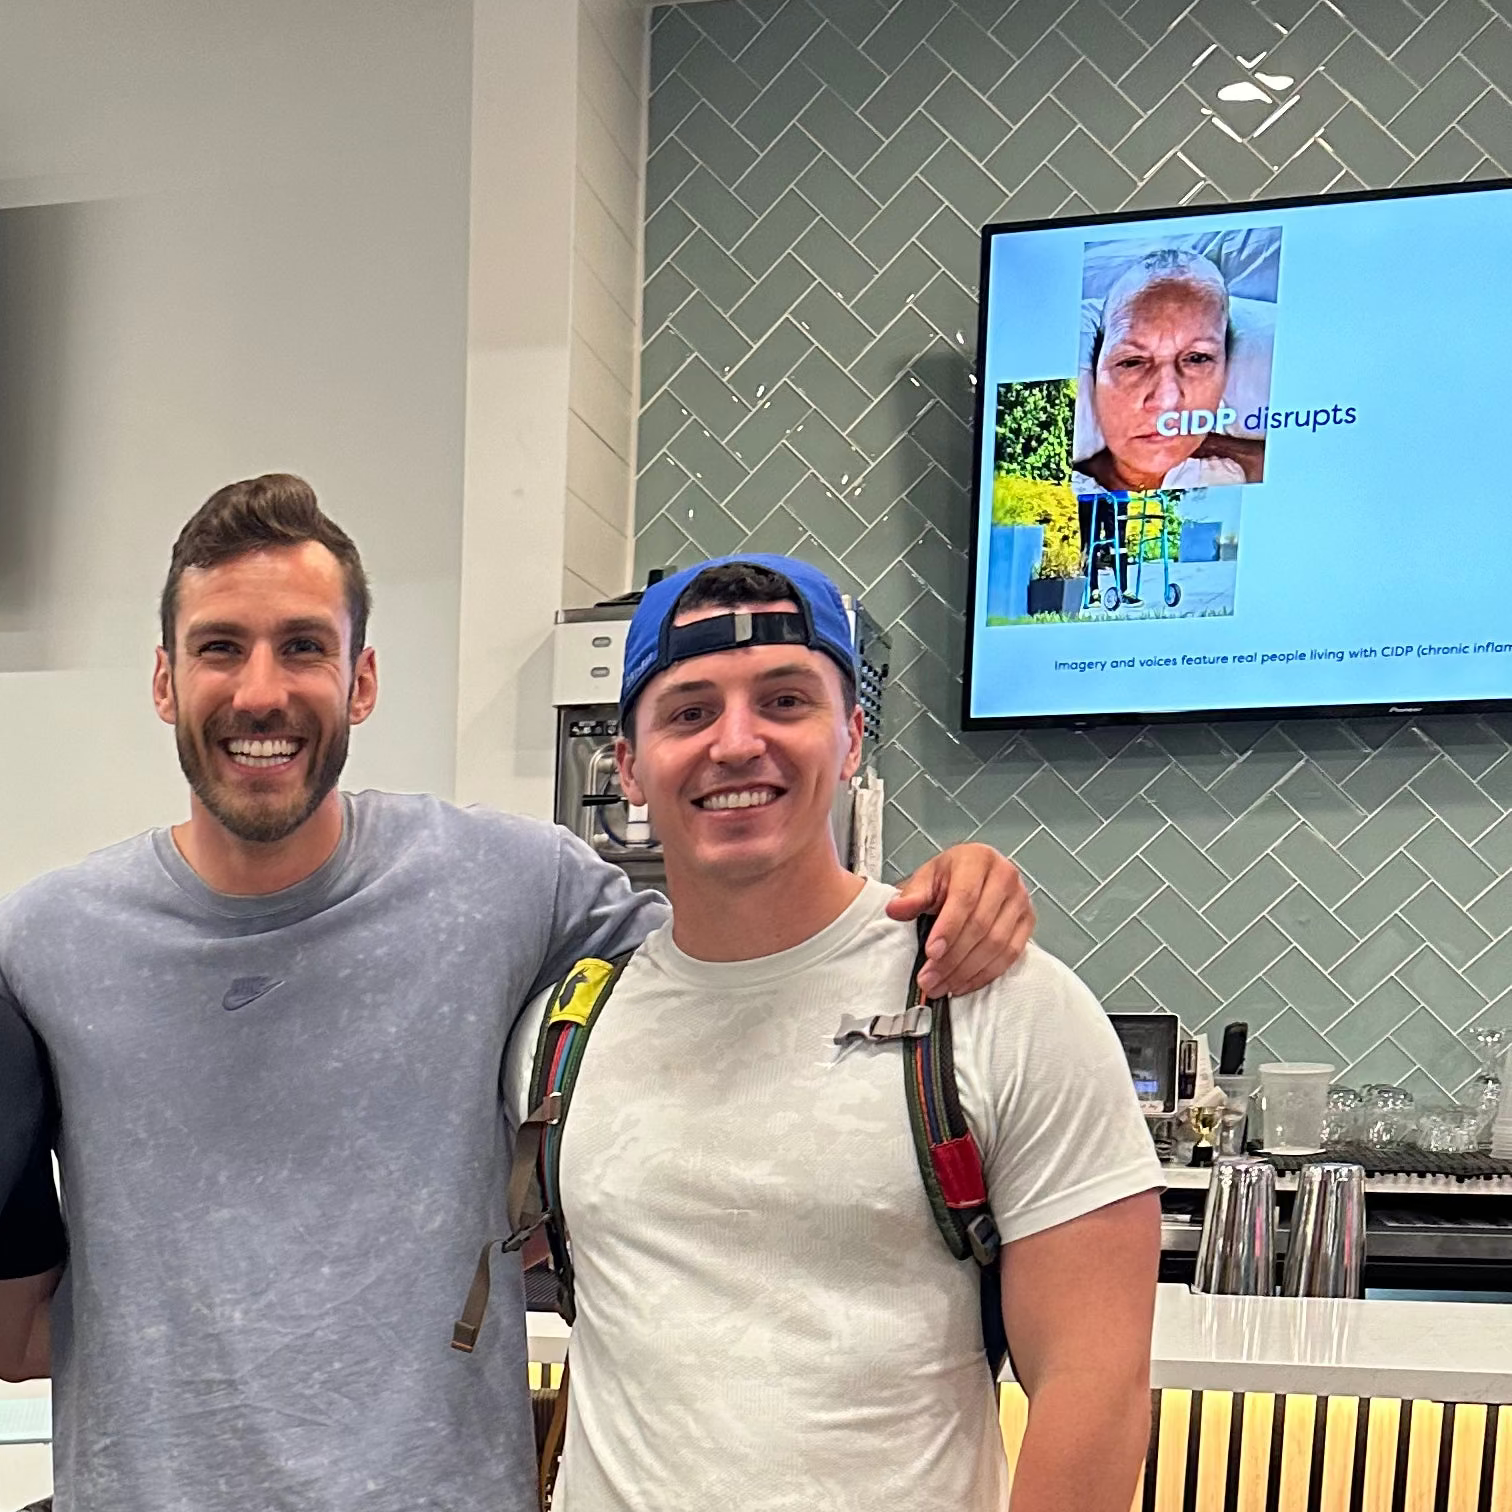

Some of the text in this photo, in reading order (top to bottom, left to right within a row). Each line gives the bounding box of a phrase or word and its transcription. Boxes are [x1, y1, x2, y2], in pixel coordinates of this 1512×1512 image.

[1156, 404, 1357, 437] CIDP disrupts
[1054, 660, 1107, 673] Imagery
[1110, 657, 1135, 669] and
[1139, 656, 1178, 667] voices
[1181, 654, 1228, 665] feature
[1232, 652, 1257, 664] real
[1261, 650, 1306, 665] people
[1309, 648, 1345, 662] living
[1349, 646, 1377, 659] with
[1381, 645, 1414, 657] CIDP
[1417, 644, 1469, 658] (chronic
